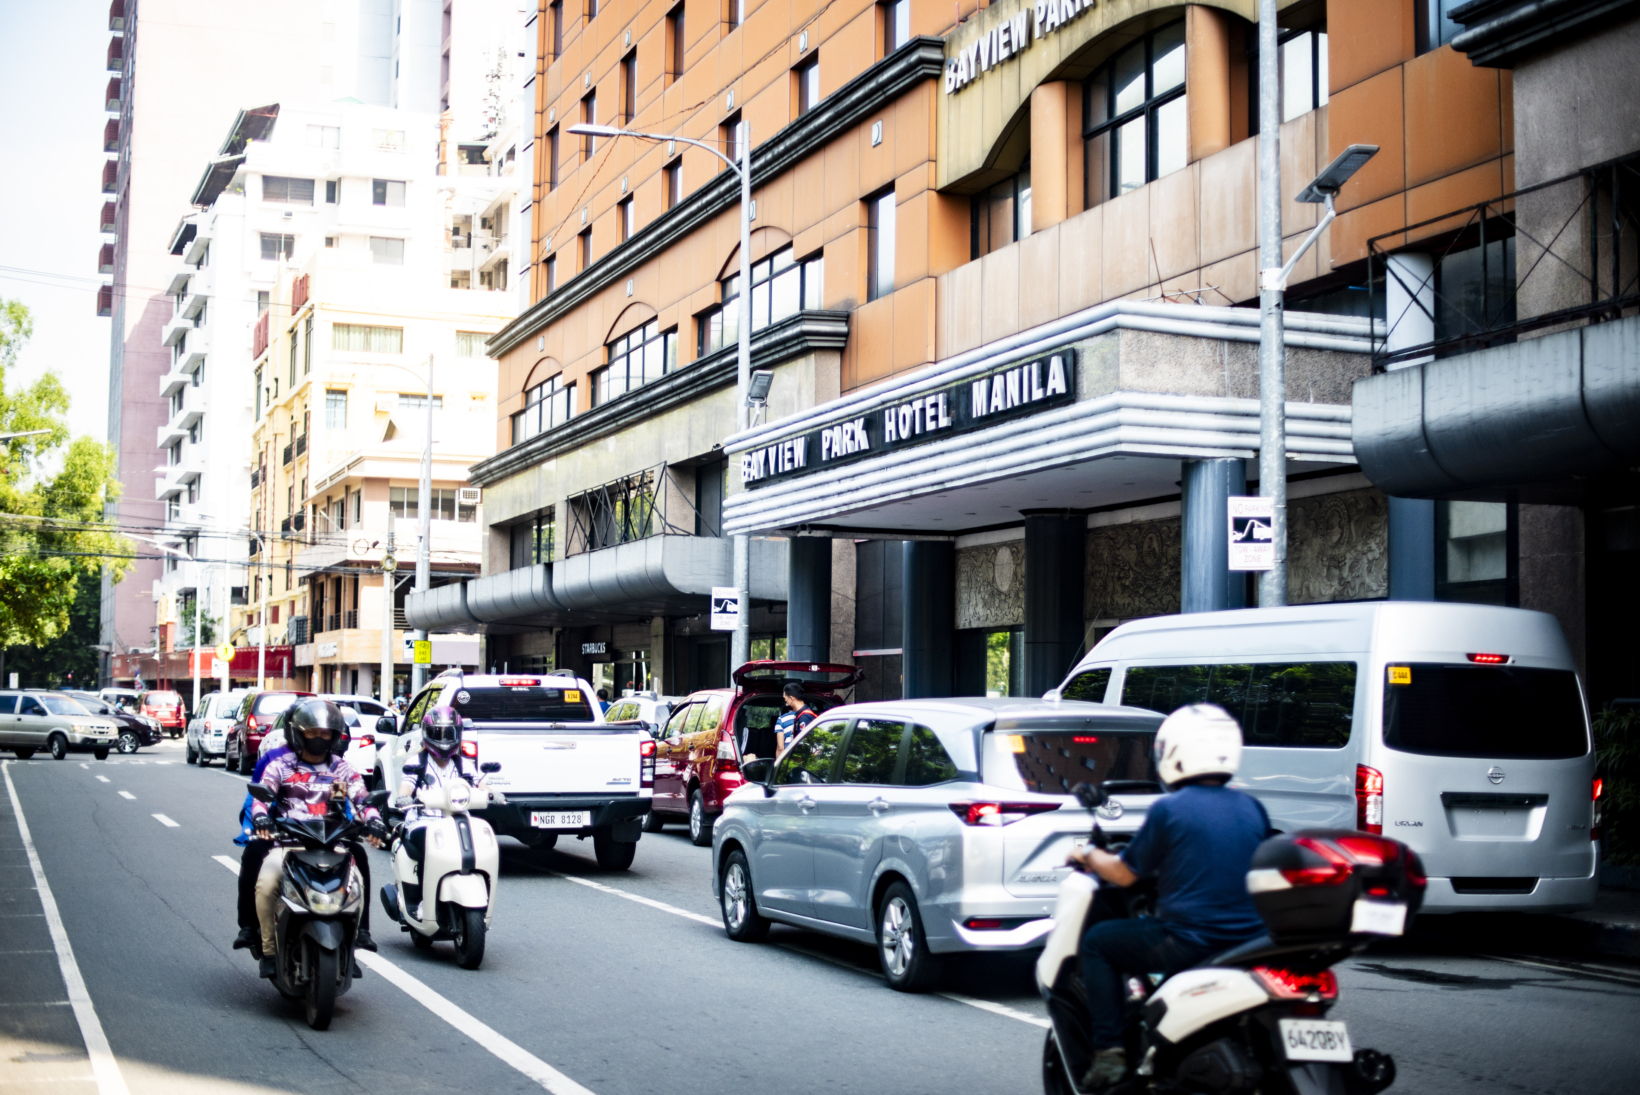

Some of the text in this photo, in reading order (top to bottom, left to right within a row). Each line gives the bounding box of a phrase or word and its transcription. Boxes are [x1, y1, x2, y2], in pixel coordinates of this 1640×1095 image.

[945, 7, 1031, 95] BAYVIEW
[741, 355, 1067, 484] BAYVIEW PARK HOTEL MANILA
[1232, 503, 1271, 514] NO PARKING
[1234, 545, 1248, 553] TOW
[1254, 545, 1271, 553] AWAY
[1244, 554, 1261, 562] ZONE
[582, 642, 606, 654] STARBUCKS
[308, 783, 331, 792] 125
[539, 814, 582, 824] NGR 8128
